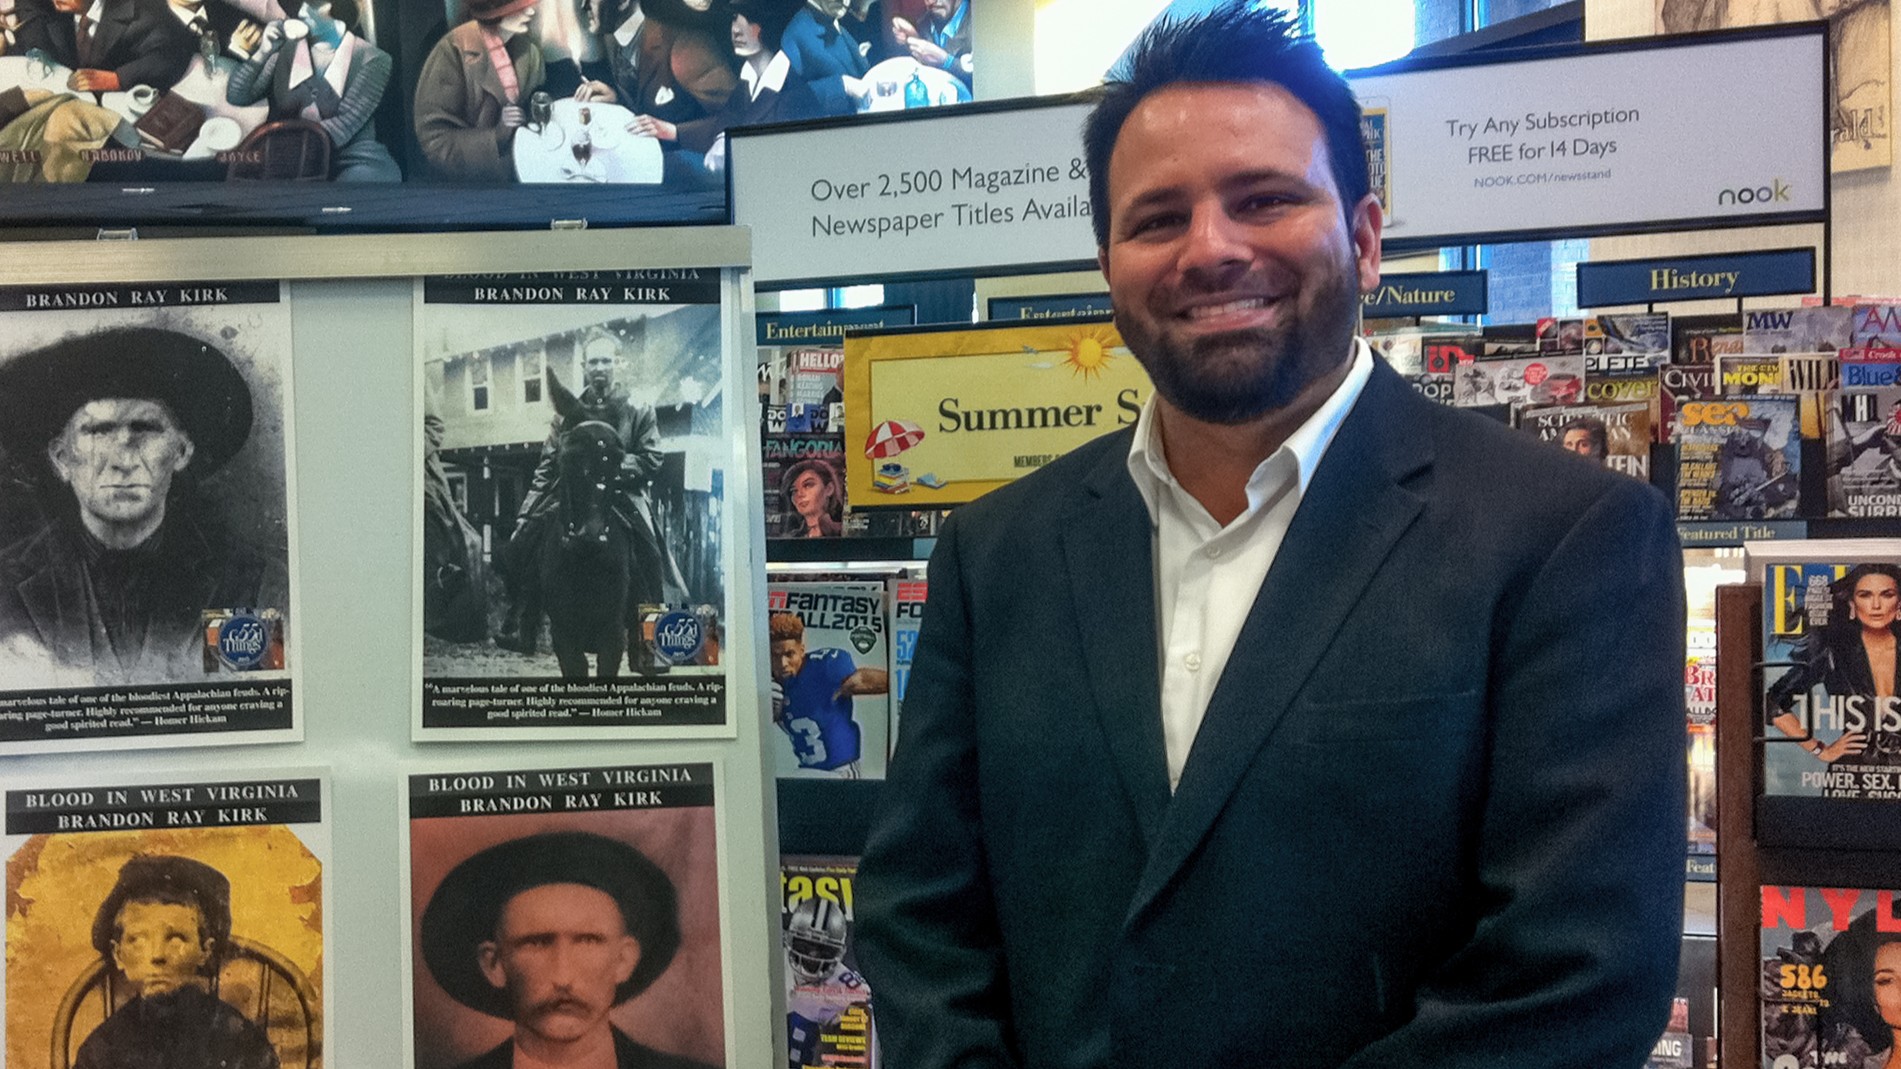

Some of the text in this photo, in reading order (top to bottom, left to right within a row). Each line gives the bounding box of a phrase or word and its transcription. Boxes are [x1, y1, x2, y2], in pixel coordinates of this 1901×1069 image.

[1446, 108, 1640, 140] Try Any Subscription
[1468, 138, 1617, 164] FREE for 14 Days
[811, 158, 1089, 201] Over 2,500 Magazine &
[1474, 169, 1612, 188] NOOK.COM/newsstand
[1718, 178, 1791, 206] nook
[812, 195, 1093, 239] Newspaper Titles Availa
[1650, 268, 1741, 293] History
[27, 288, 228, 308] BRANDON RAY KIRK
[474, 287, 671, 300] BRANDON RAY KIRK
[1747, 311, 1793, 331] MW
[938, 397, 1103, 433] Summer
[1743, 523, 1776, 540] Title
[223, 638, 262, 654] Things
[659, 632, 697, 649] Things
[49, 695, 67, 705] tale
[68, 694, 80, 704] of
[80, 696, 98, 704] one
[99, 693, 110, 703] of
[111, 693, 127, 702] the
[128, 691, 171, 702] bloodiest
[172, 688, 232, 702] Appalachian
[263, 687, 270, 696] A
[442, 684, 489, 694] marvelous
[491, 684, 508, 693] tale
[509, 684, 520, 693] of
[539, 683, 550, 693] of
[551, 683, 566, 693] the
[567, 682, 608, 693] bloodiest
[610, 682, 667, 694] Appalachian
[697, 682, 705, 691] A
[86, 707, 117, 718] Highly
[120, 704, 186, 715] recommended
[188, 703, 202, 712] for
[204, 702, 237, 713] anyone
[239, 700, 275, 711] craving
[432, 697, 466, 708] roaring
[526, 696, 556, 707] Highly
[559, 696, 622, 705] recommended
[624, 696, 639, 705] for
[640, 697, 673, 706] anyone
[674, 695, 709, 706] craving
[487, 709, 510, 720] good
[511, 708, 546, 719] spirited
[592, 707, 625, 717] Homer
[626, 707, 662, 717] Hickam
[1793, 694, 1867, 731] THIS
[45, 720, 68, 732] good
[70, 719, 107, 732] spirited
[155, 716, 188, 726] Homer
[189, 714, 227, 724] Hickam
[428, 768, 692, 792] BLOOD IN WEST VIRGINIA
[1802, 771, 1896, 790] POWER. SEX.
[26, 784, 299, 808] BLOOD IN WEST VIRGINIA
[460, 791, 663, 813] BRANDON RAY KIRK
[57, 807, 268, 830] BRANDON RAY KIRK
[1780, 963, 1828, 989] 586
